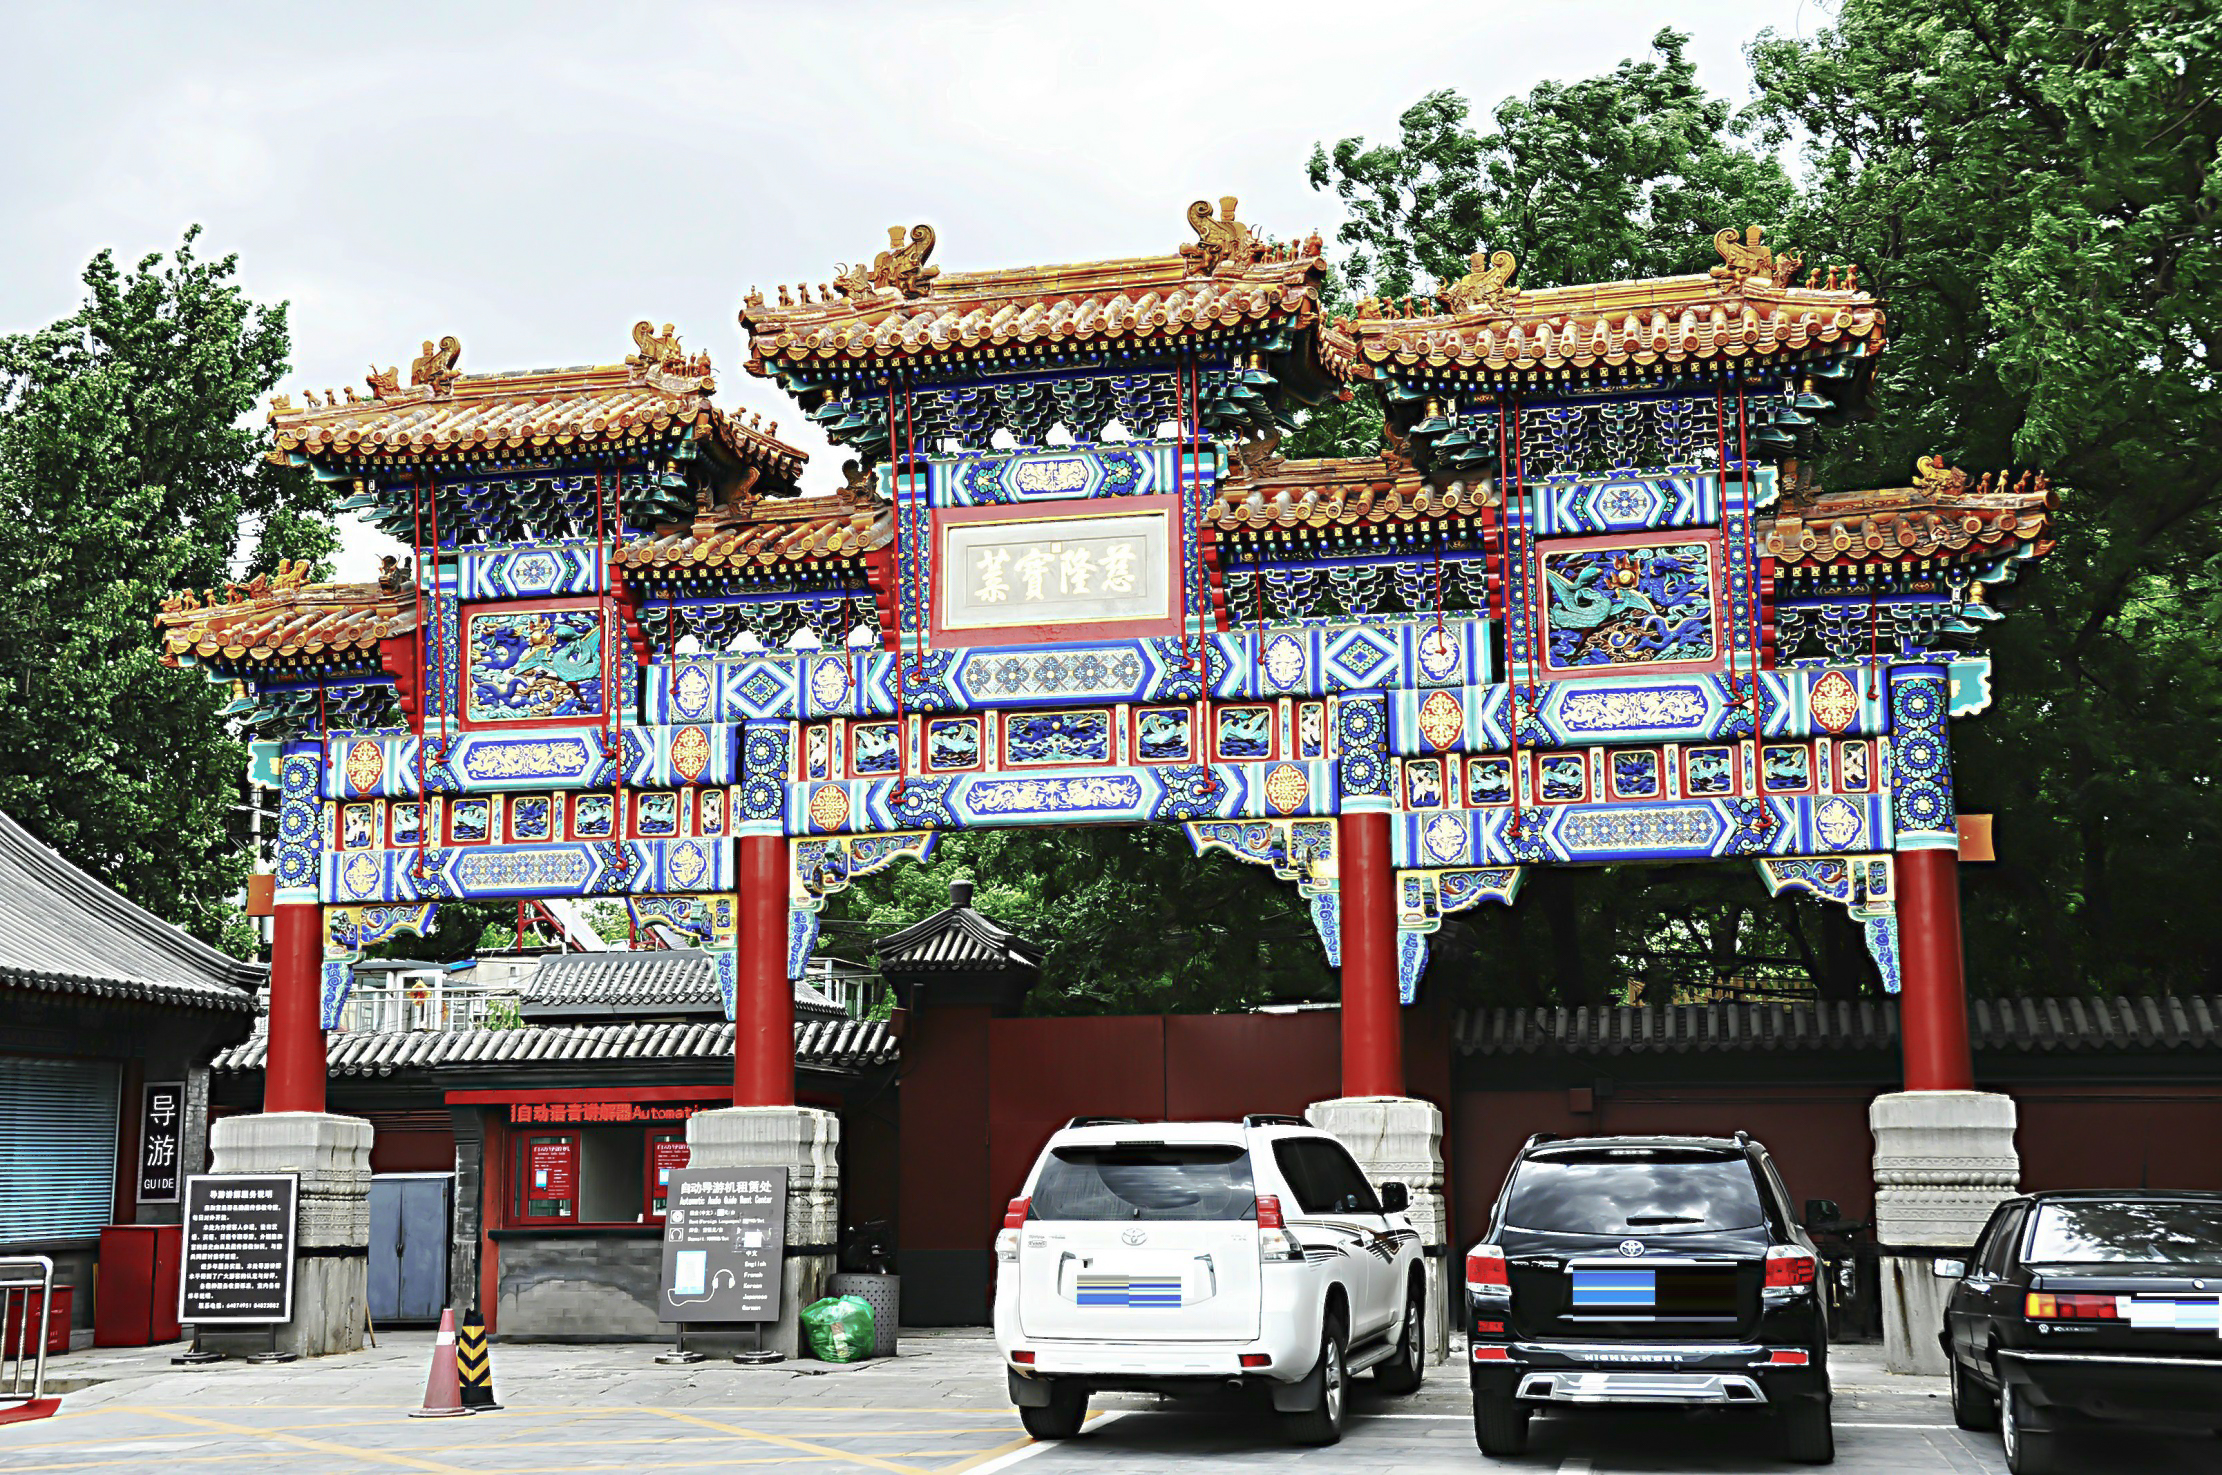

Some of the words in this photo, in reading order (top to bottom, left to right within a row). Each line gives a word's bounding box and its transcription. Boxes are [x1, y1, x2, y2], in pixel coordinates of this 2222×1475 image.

[147, 1095, 176, 1166] 导游
[144, 1178, 174, 1190] GUIDE
[681, 1180, 773, 1195] 自动导游机租赁处
[744, 1260, 767, 1268] English
[1584, 1354, 1684, 1362] HIGHLANDER
